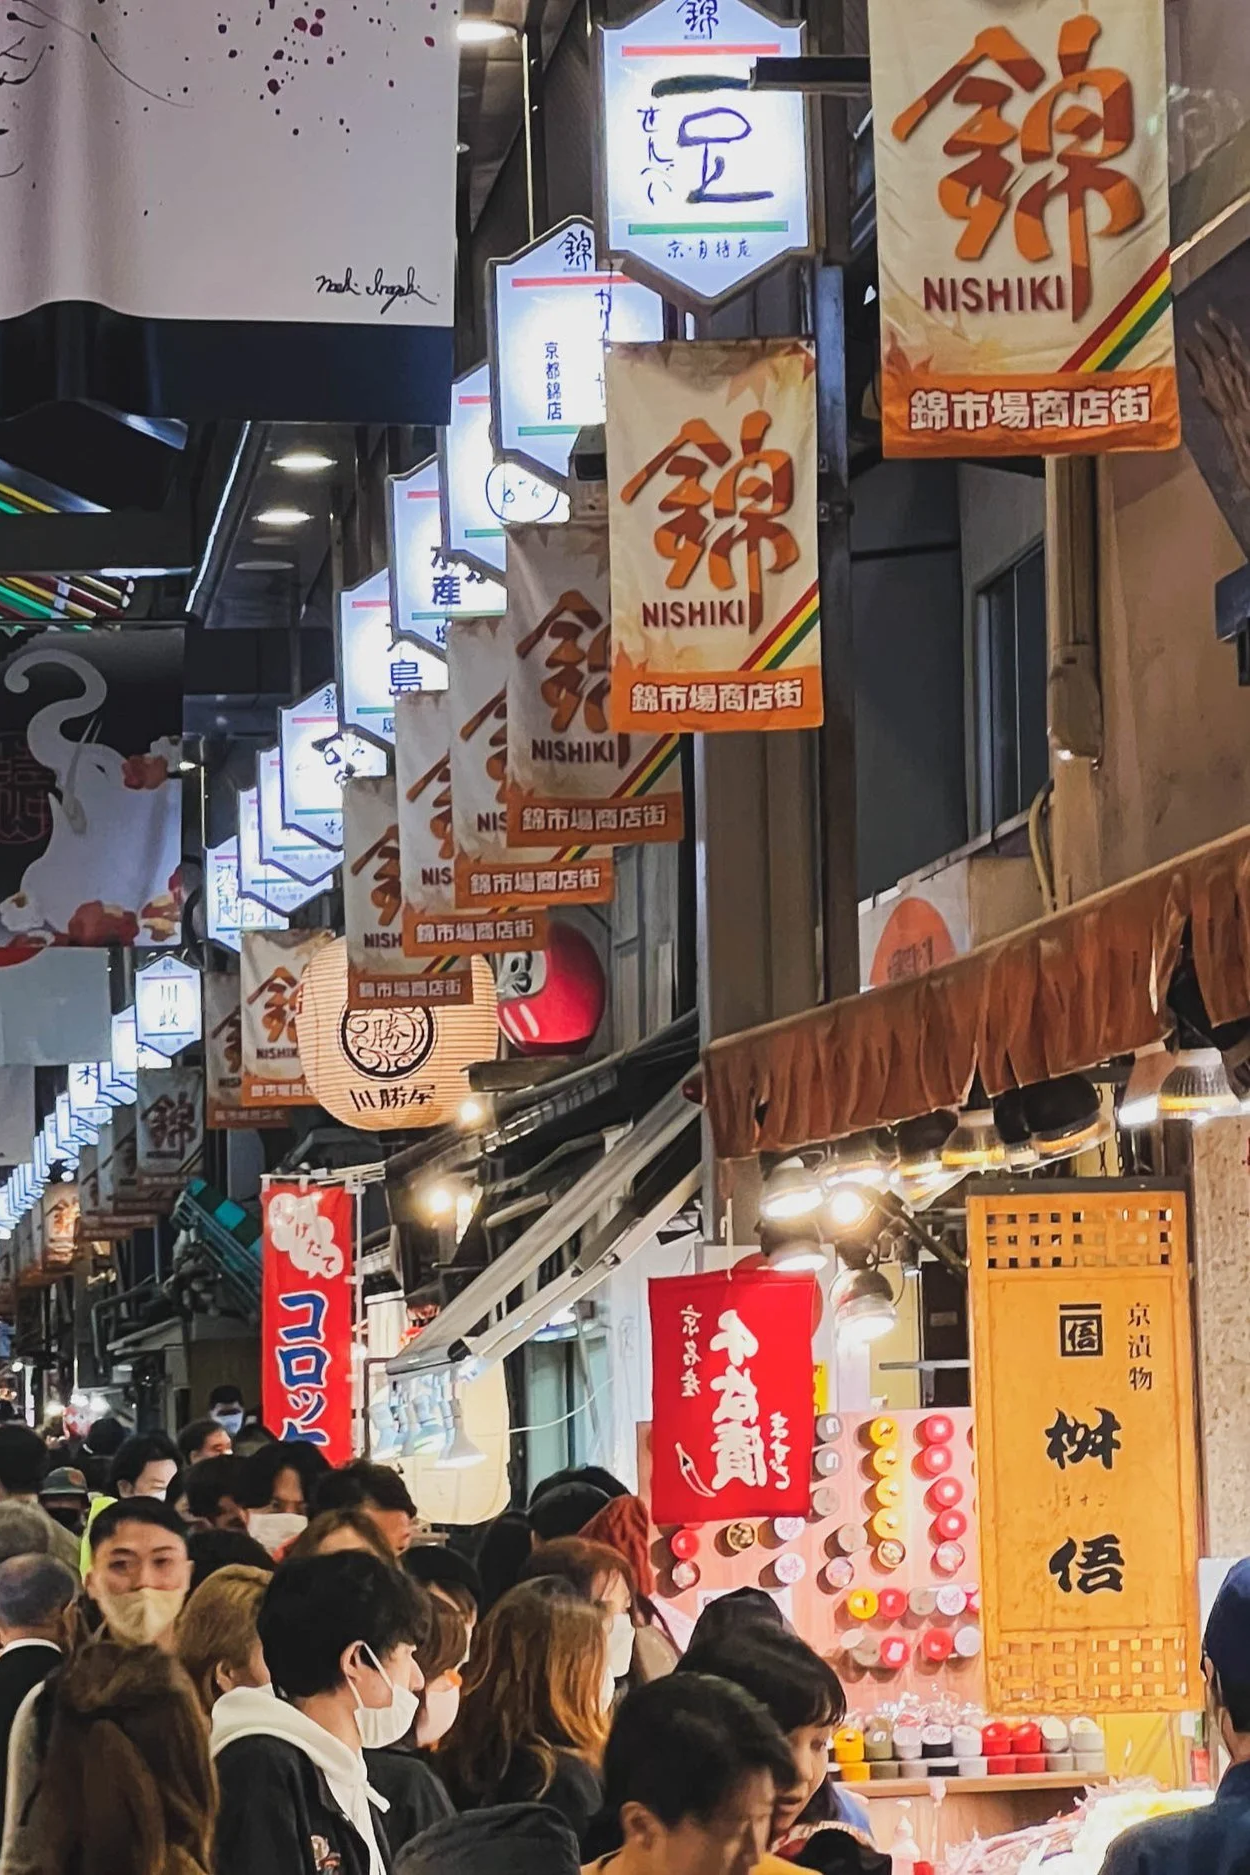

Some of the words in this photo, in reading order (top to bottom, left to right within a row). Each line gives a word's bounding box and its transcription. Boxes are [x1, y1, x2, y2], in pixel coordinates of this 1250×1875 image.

[892, 14, 1144, 322] 錦
[558, 230, 592, 272] 錦
[924, 276, 1066, 312] NISHIKI
[545, 341, 562, 421] 京都錦店
[909, 384, 1151, 431] 錦市場商店街
[620, 410, 800, 634] 錦
[642, 599, 744, 628] NISHIKI
[631, 679, 803, 713] 錦市場商店街
[532, 739, 614, 763] NISHIKI
[522, 805, 665, 831] 錦市場商店街
[470, 868, 600, 895] 錦市場商店街
[415, 919, 533, 943] 錦市場商店街
[1126, 1302, 1153, 1392] 京漬物
